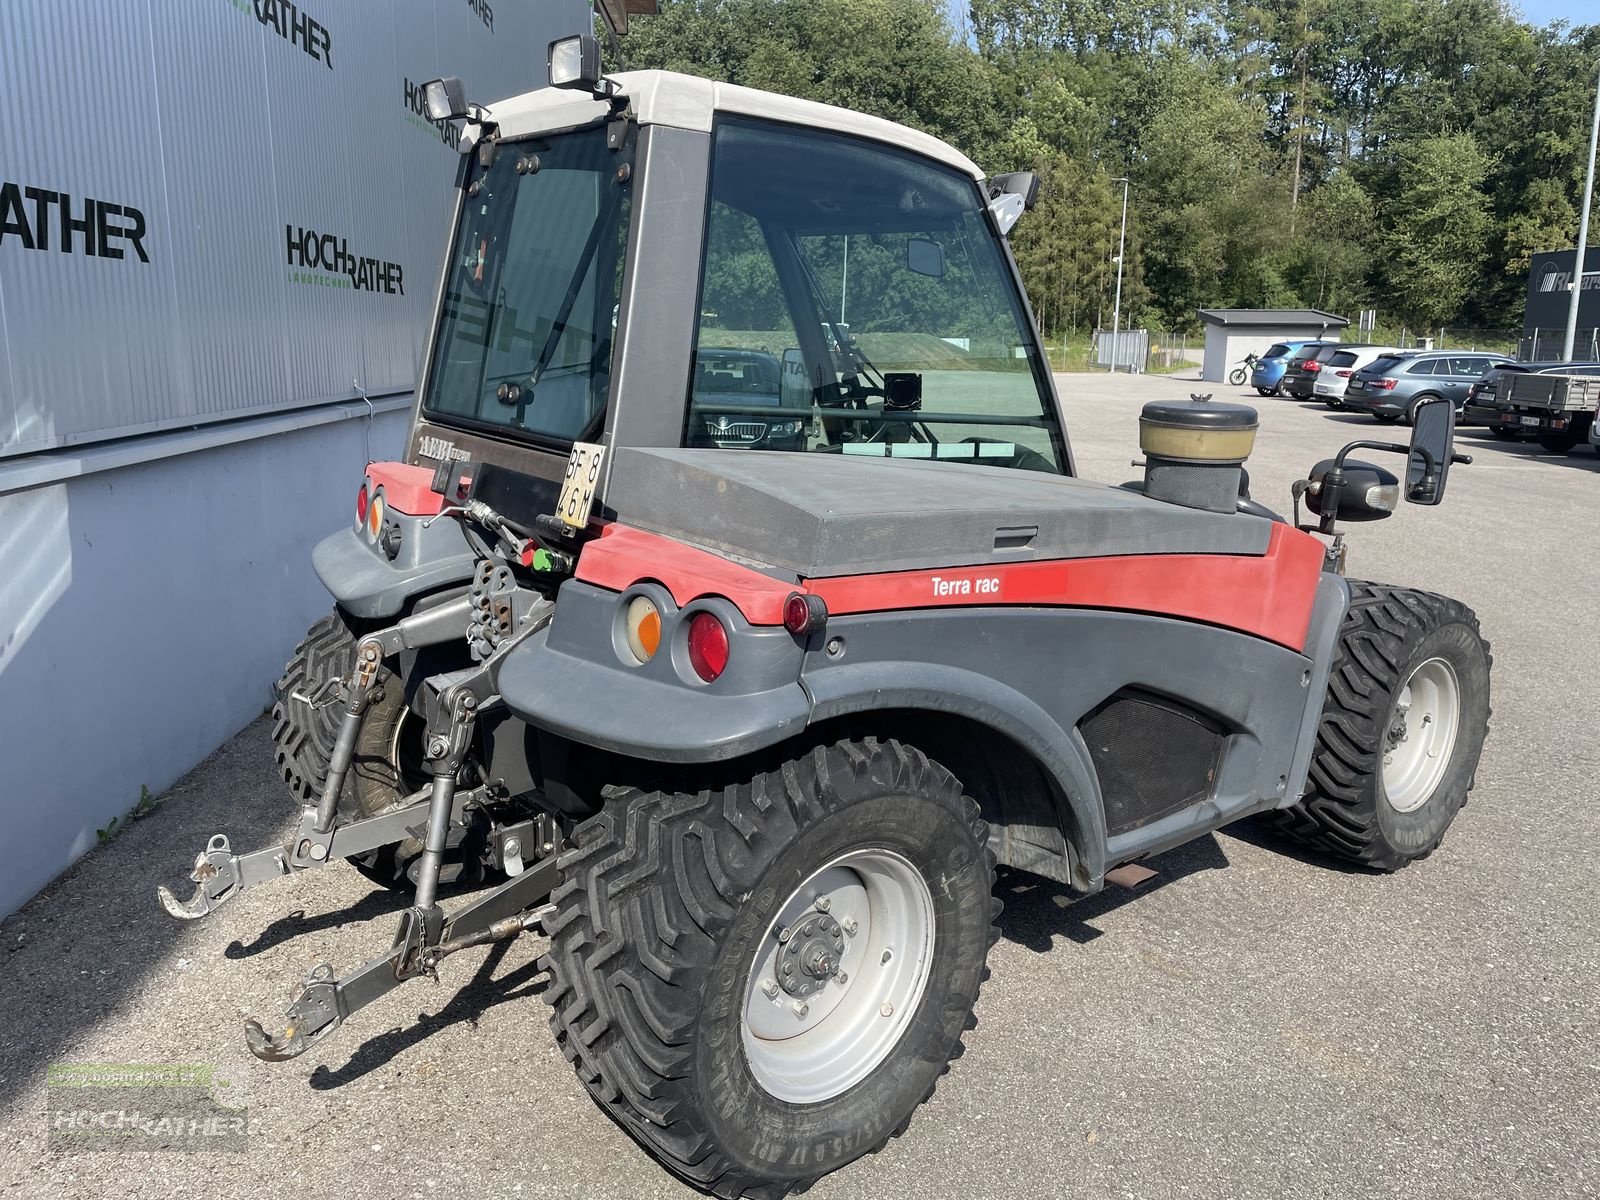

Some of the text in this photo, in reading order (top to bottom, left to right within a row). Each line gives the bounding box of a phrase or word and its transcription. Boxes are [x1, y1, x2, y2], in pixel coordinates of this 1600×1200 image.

[0, 182, 150, 264] ATHER
[286, 224, 405, 296] HOCHRATHER
[566, 449, 586, 480] BF
